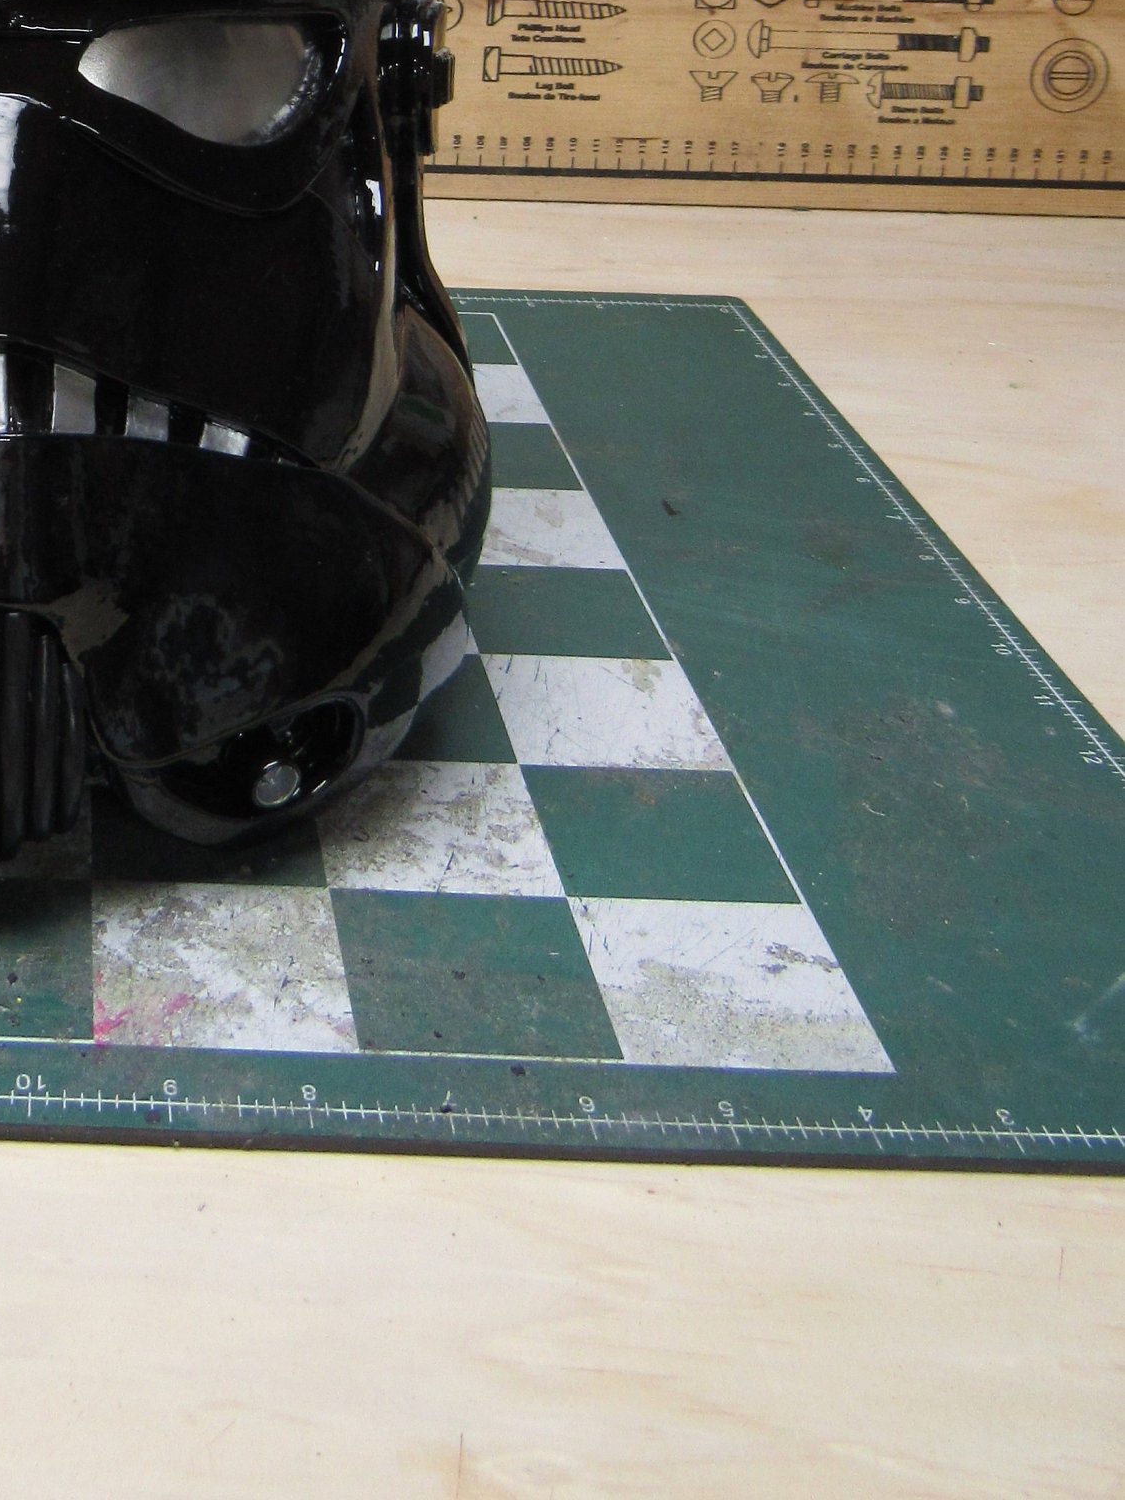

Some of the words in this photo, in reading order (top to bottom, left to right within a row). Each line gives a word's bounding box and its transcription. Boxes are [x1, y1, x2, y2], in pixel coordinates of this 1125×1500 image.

[991, 642, 1013, 655] 10
[1079, 750, 1103, 765] 12
[15, 1074, 46, 1090] 10
[301, 1084, 316, 1101] 8
[718, 1101, 734, 1118] 5
[858, 1105, 873, 1123] 4
[996, 1108, 1014, 1125] 3
